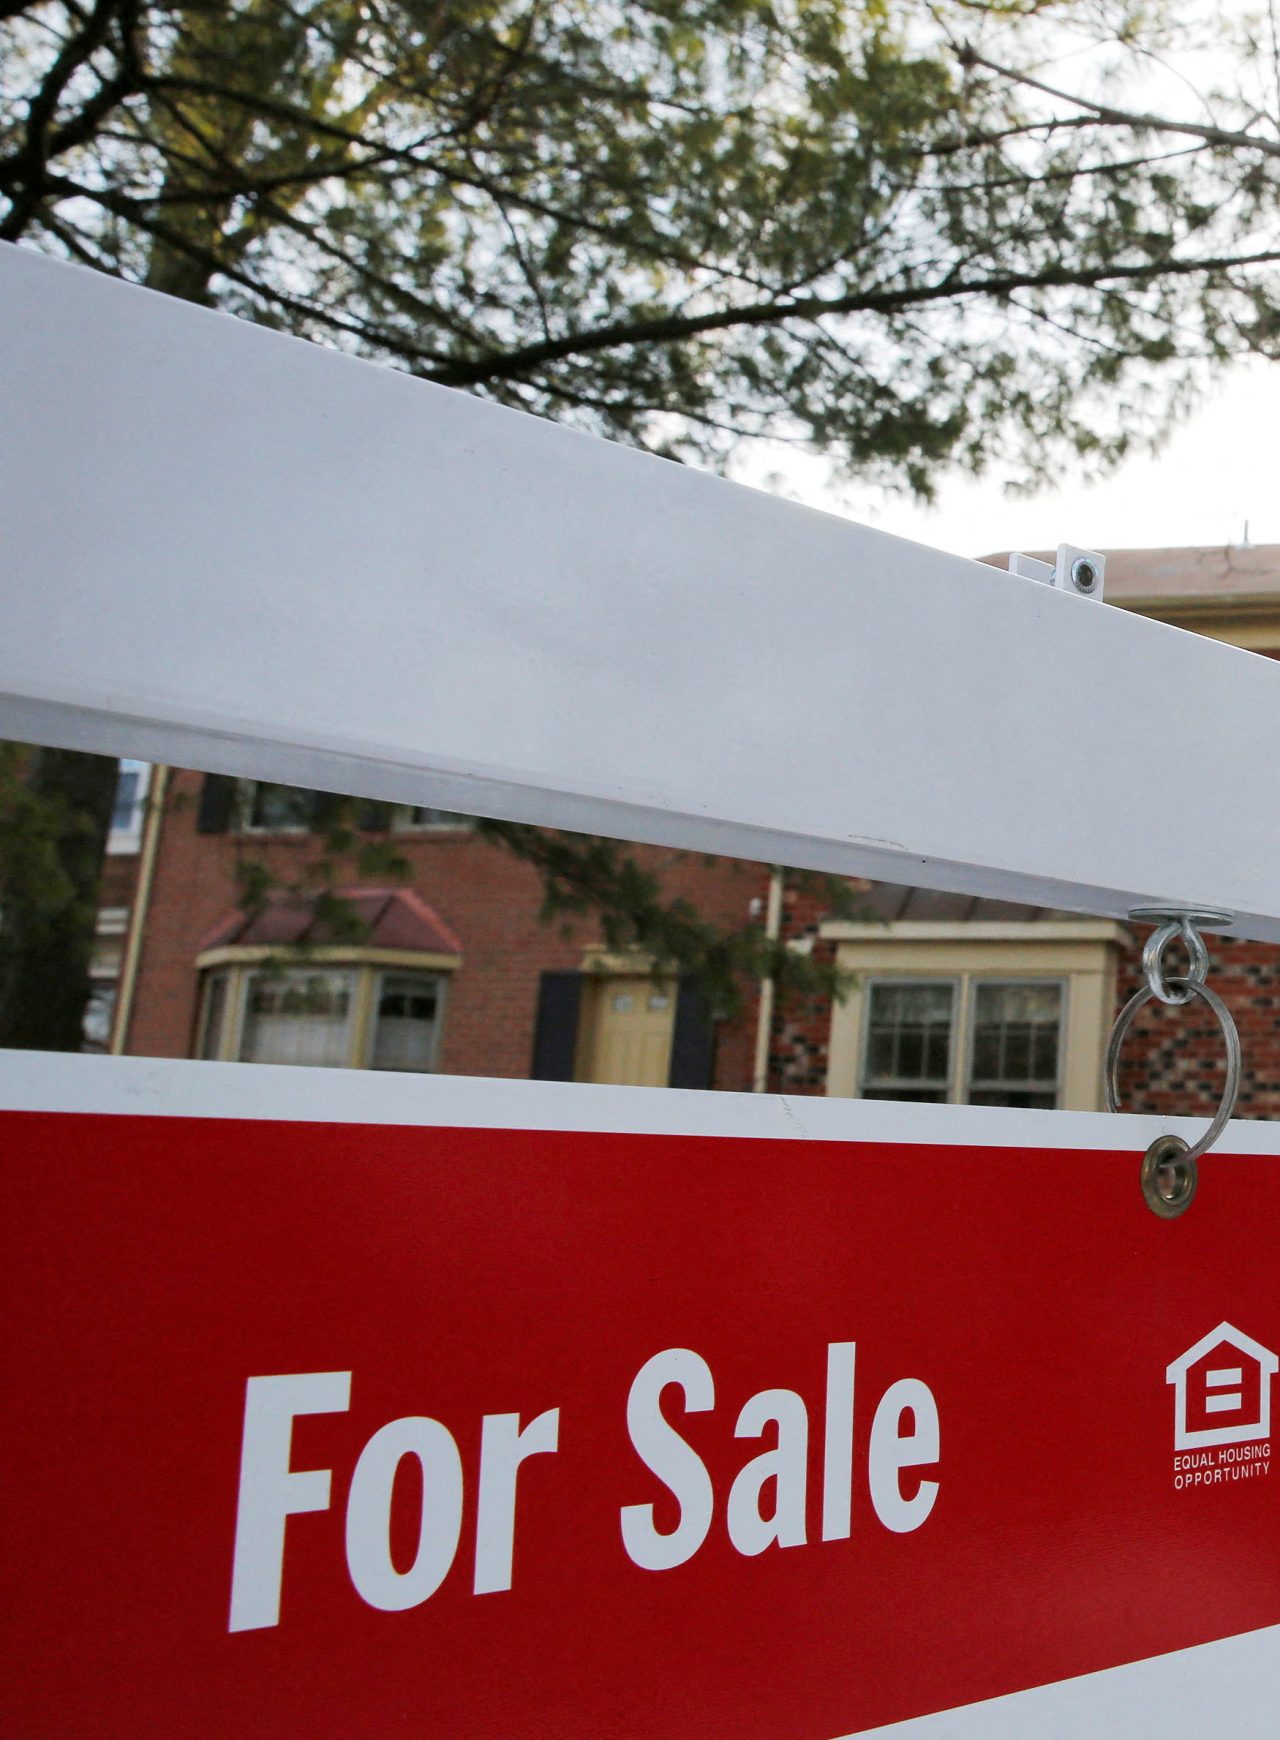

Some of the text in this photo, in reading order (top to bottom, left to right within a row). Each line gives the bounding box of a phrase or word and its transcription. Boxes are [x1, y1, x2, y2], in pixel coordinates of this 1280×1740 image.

[1174, 1443, 1271, 1471] EQUAL HOUSING
[229, 1342, 940, 1633] For Sale
[1174, 1461, 1270, 1490] OPPORTUNITY
